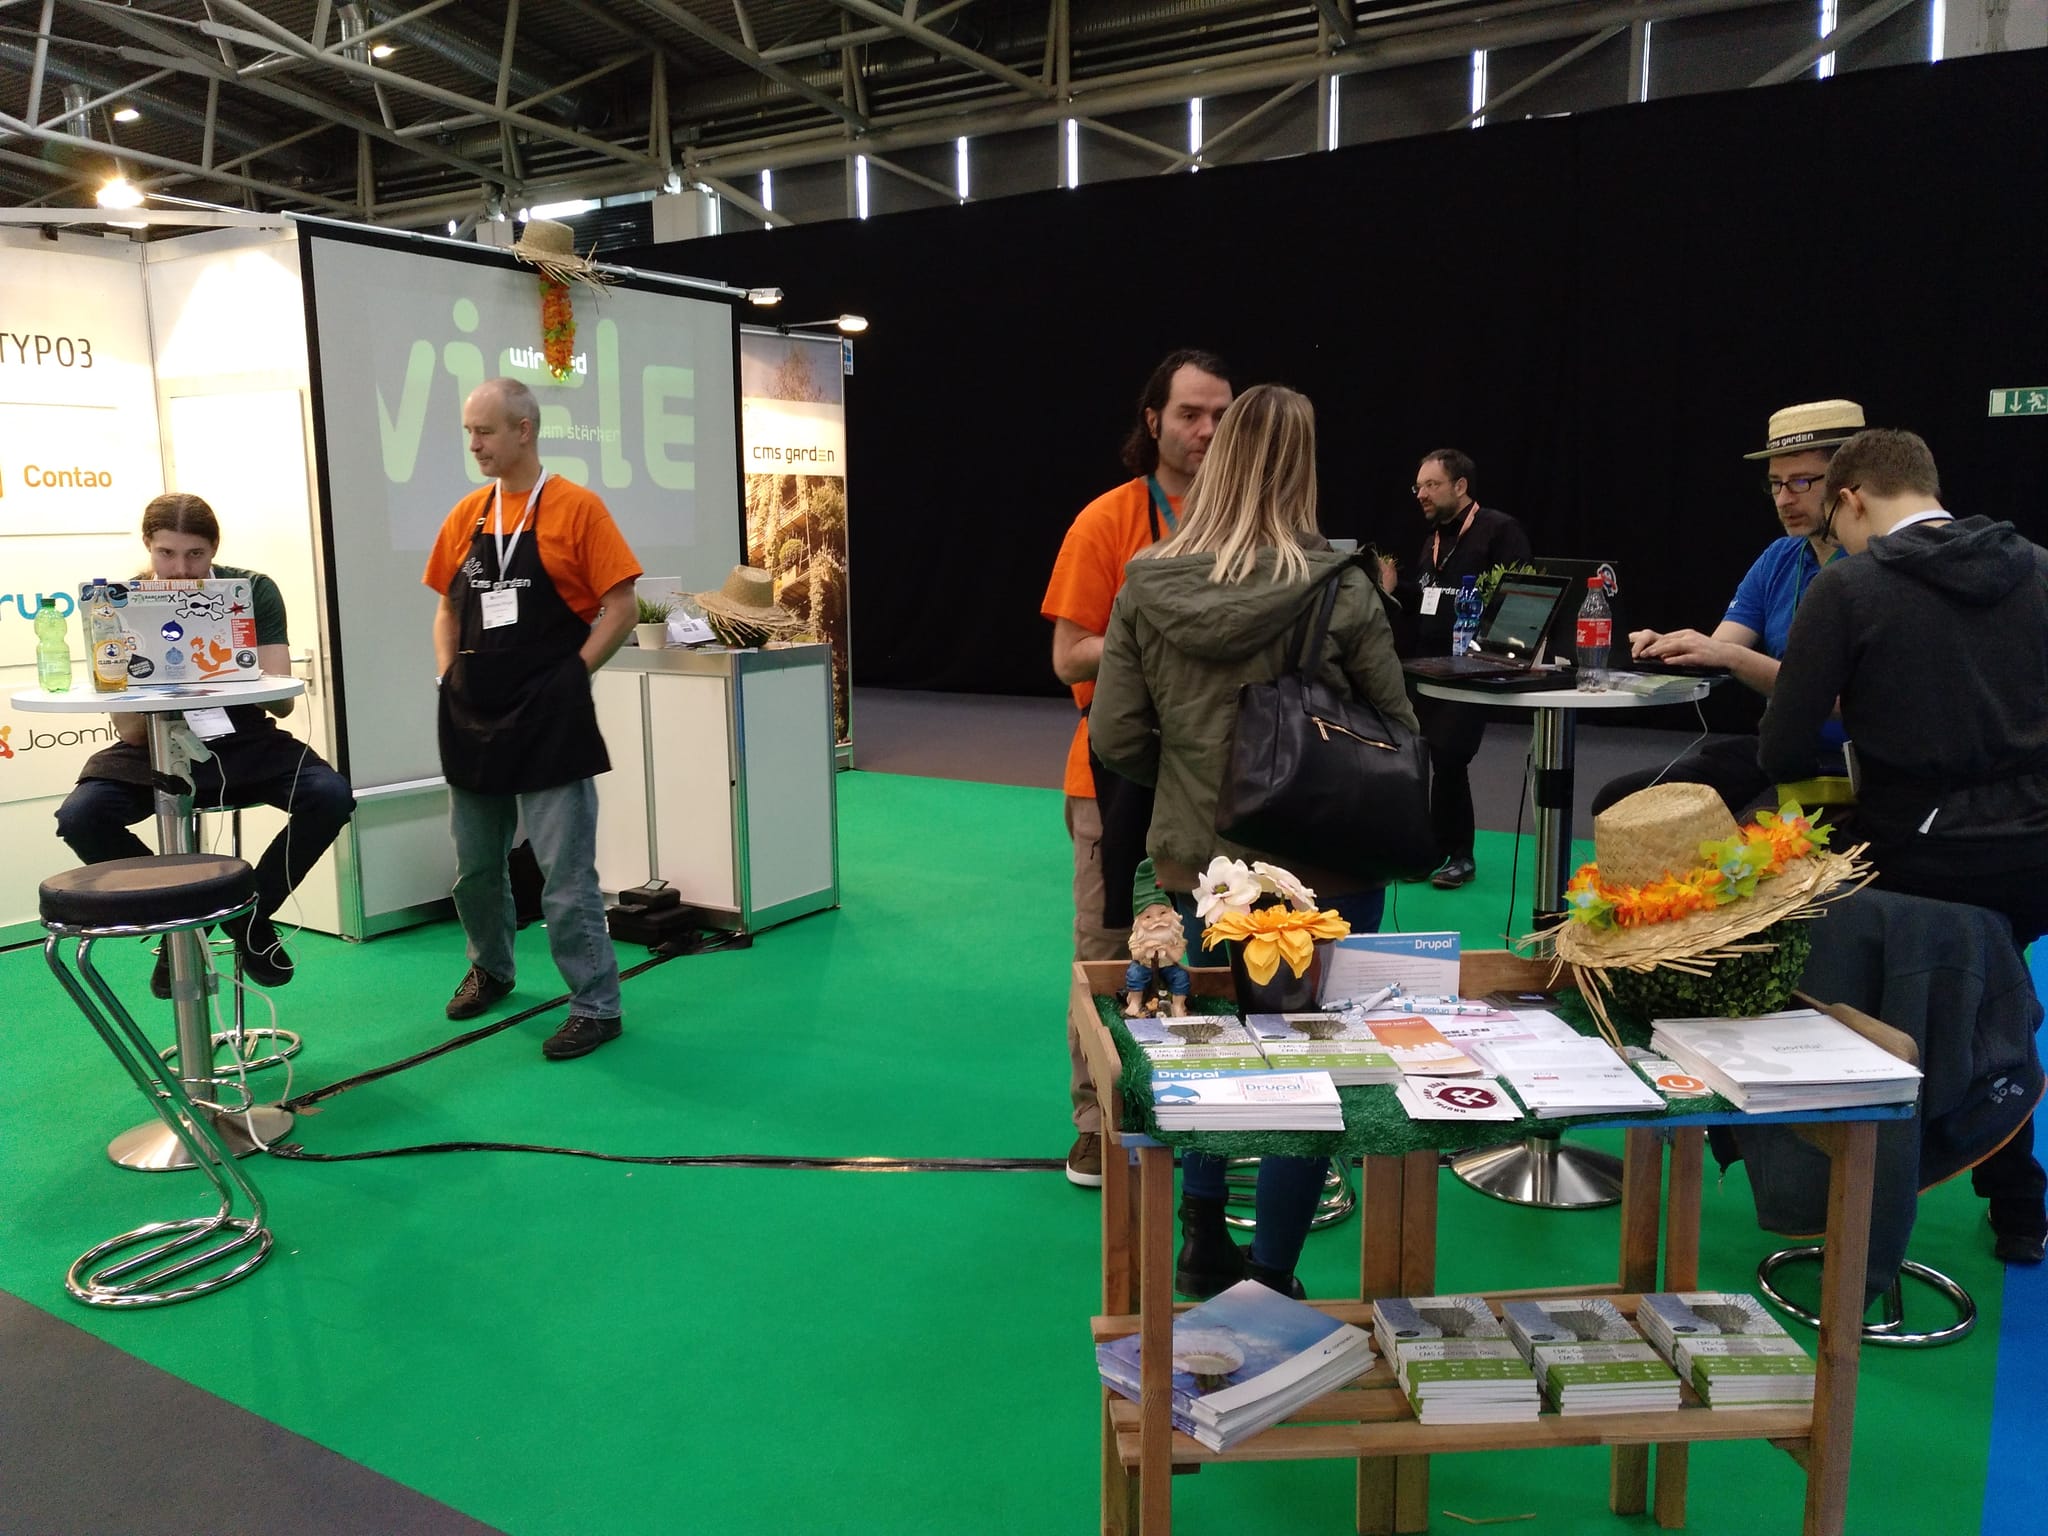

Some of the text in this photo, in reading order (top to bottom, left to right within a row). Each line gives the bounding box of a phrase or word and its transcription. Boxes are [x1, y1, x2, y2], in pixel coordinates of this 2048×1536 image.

[0, 333, 92, 368] TYPO3
[1781, 433, 1814, 446] garden
[753, 446, 834, 463] cms garden
[23, 464, 112, 488] Contao
[1415, 938, 1452, 951] Drupal
[1158, 1070, 1219, 1080] Drupal
[1246, 1082, 1301, 1092] Drupal
